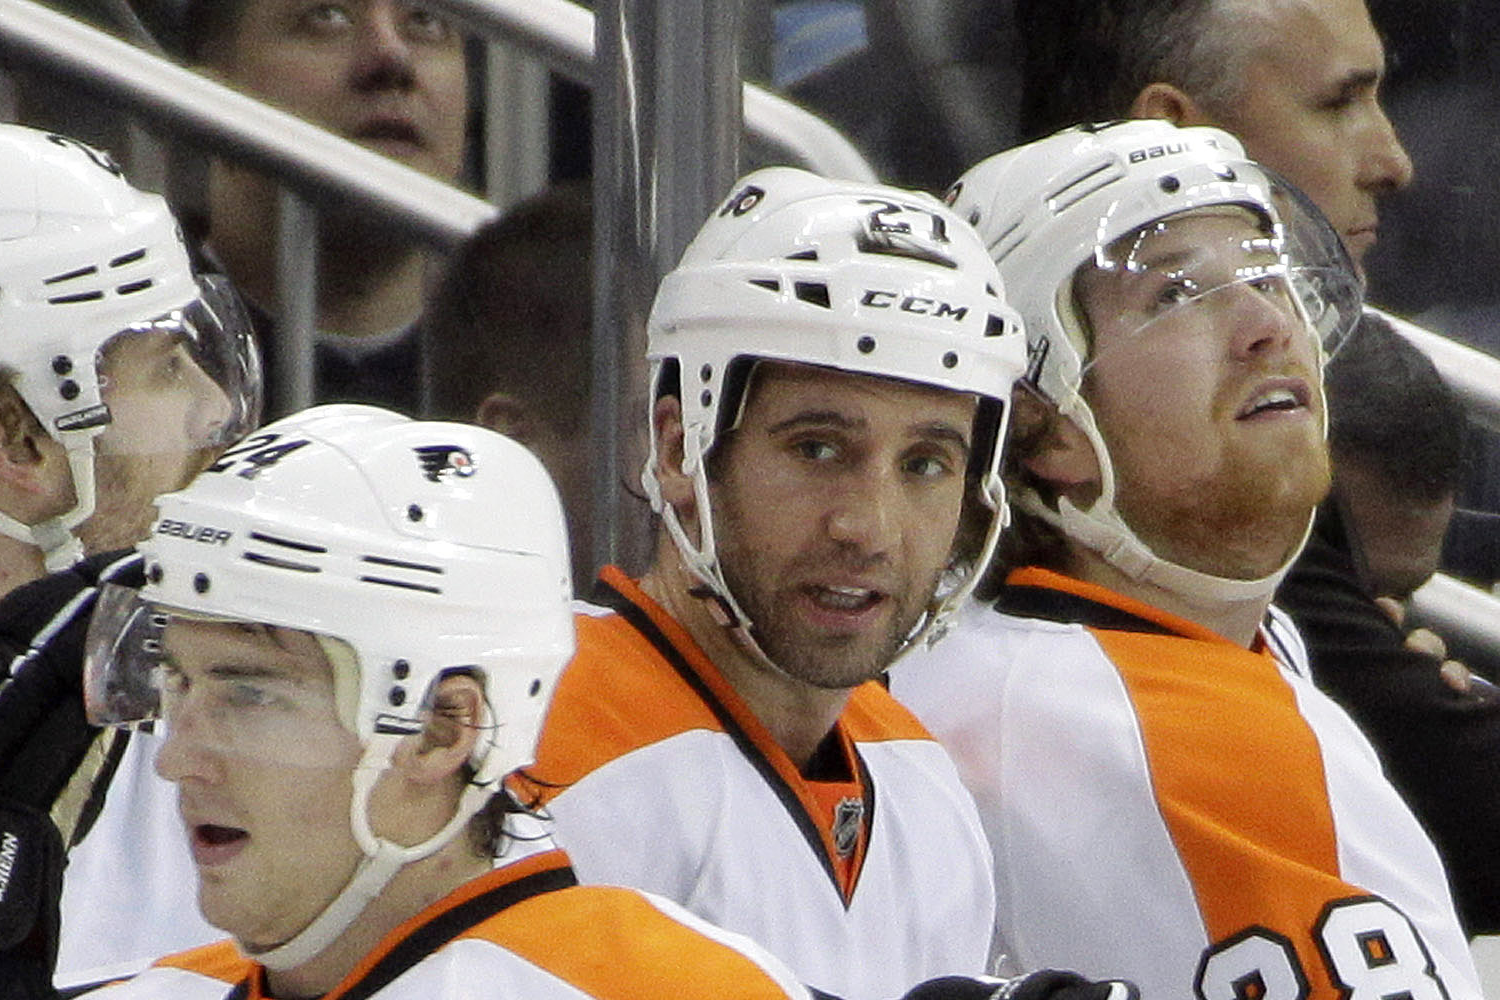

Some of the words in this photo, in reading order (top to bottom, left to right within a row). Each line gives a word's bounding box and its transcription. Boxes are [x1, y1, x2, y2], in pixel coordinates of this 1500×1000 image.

[1129, 139, 1224, 165] BAU
[860, 289, 969, 322] CCM
[206, 433, 312, 481] 24
[157, 517, 234, 546] BAUER
